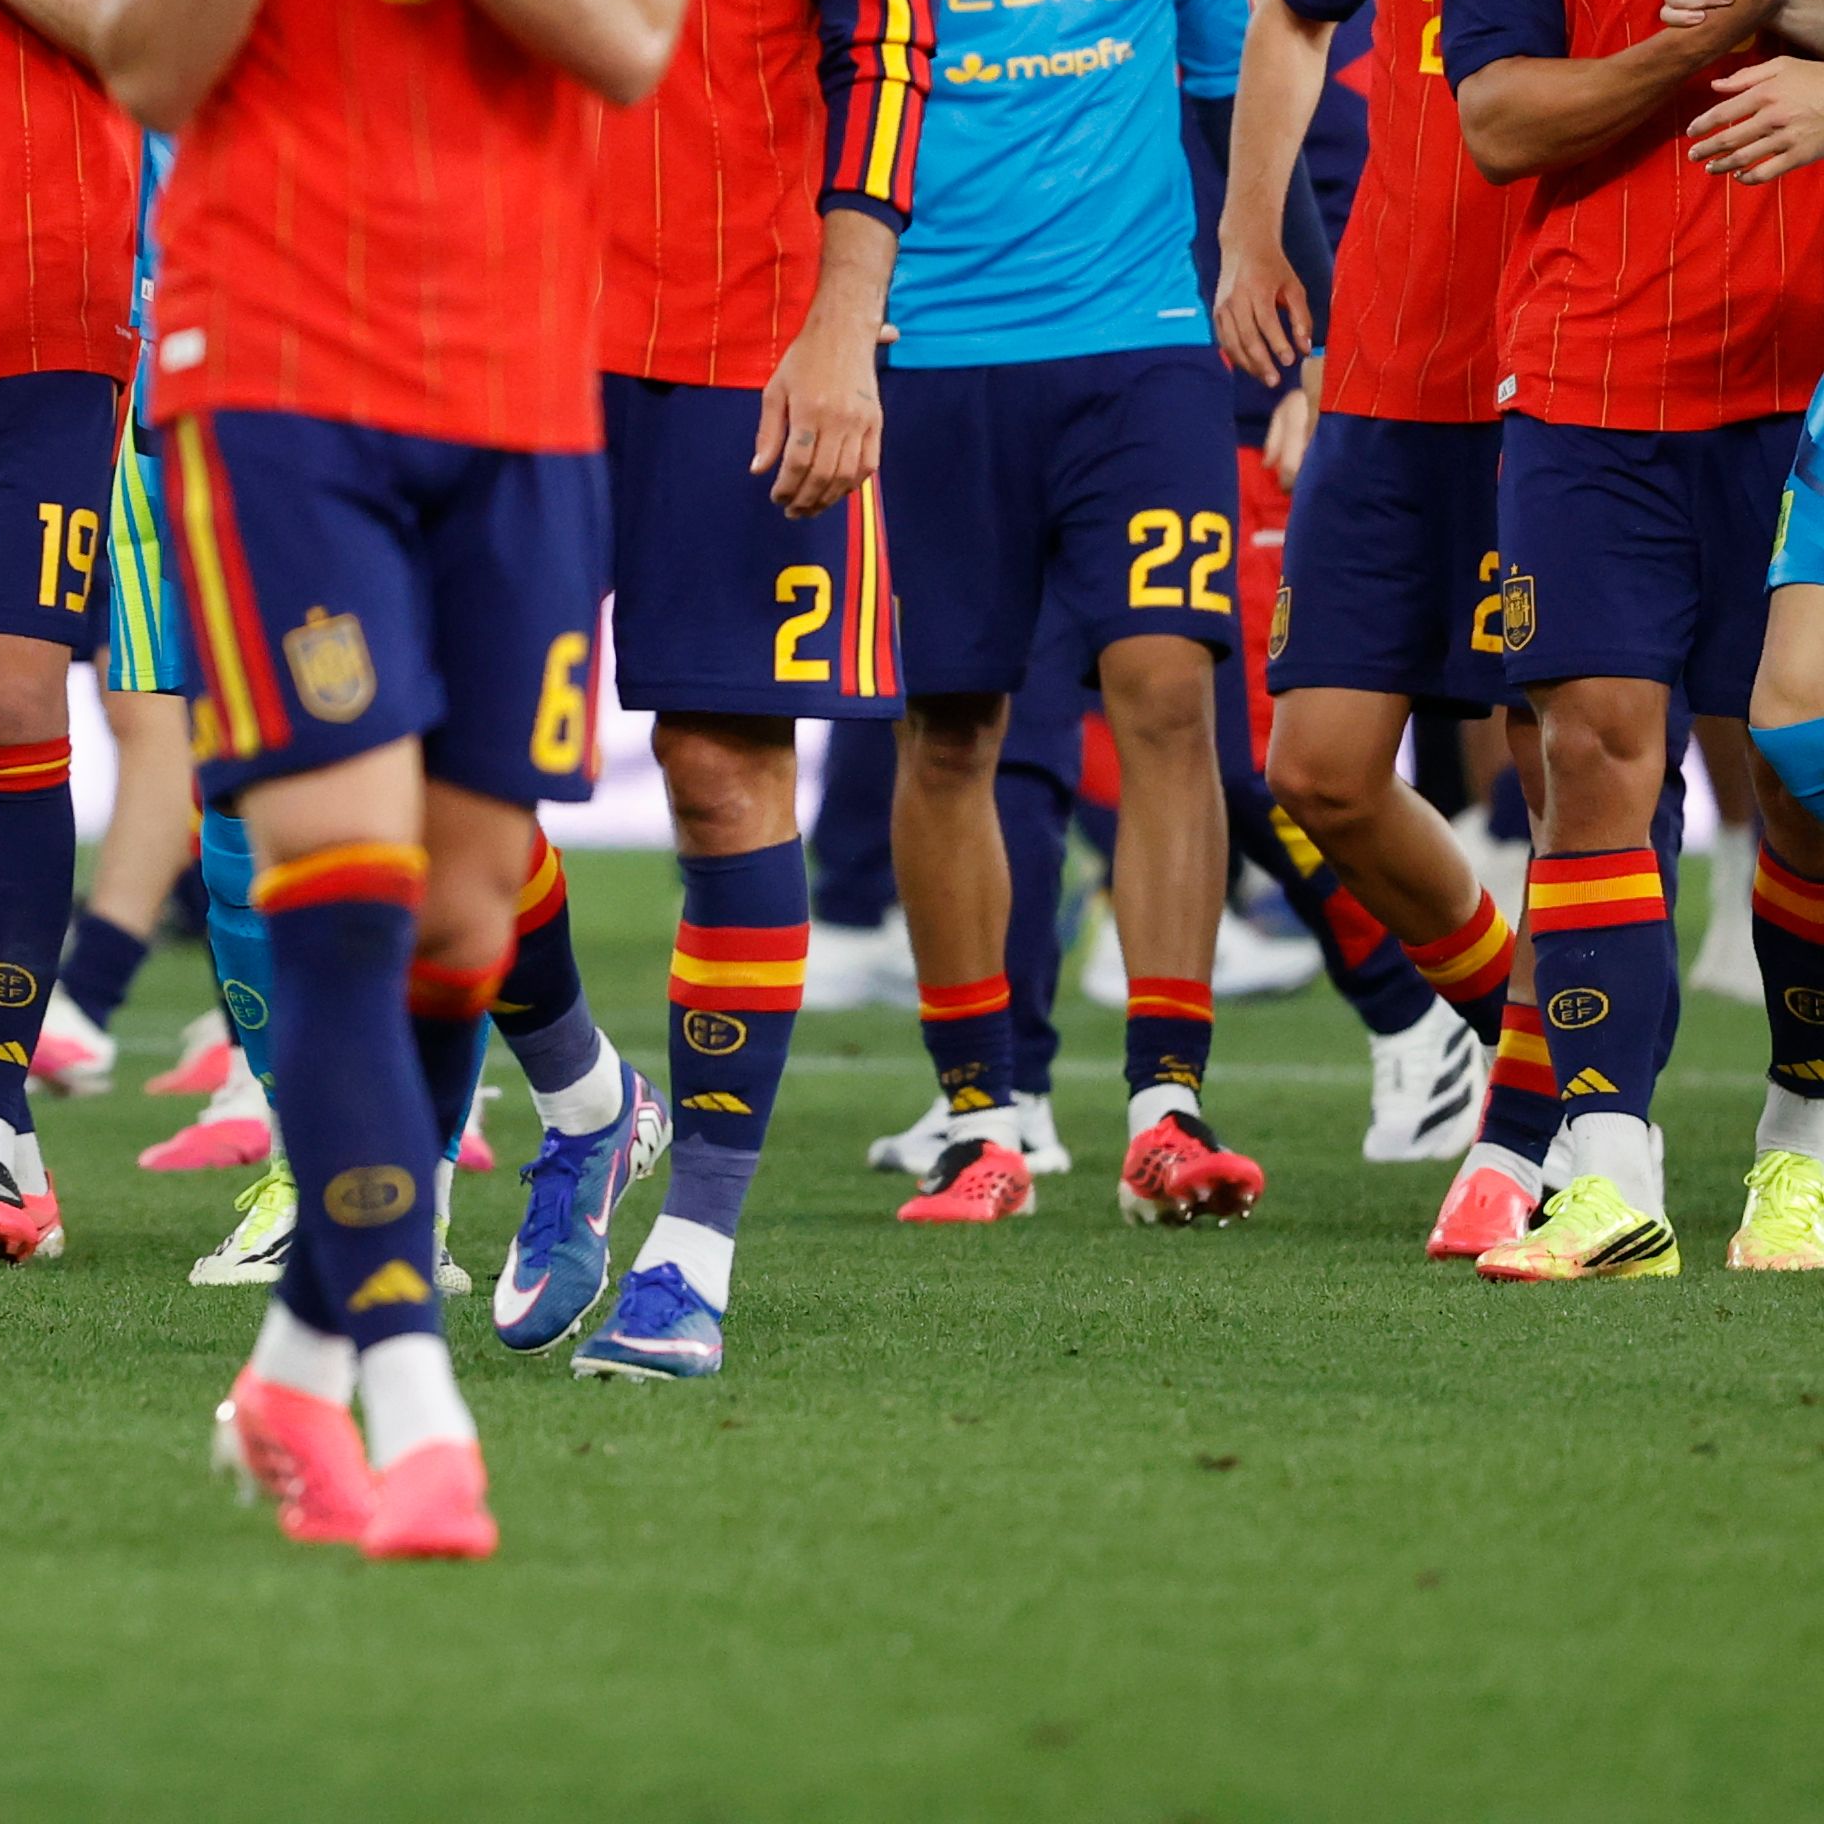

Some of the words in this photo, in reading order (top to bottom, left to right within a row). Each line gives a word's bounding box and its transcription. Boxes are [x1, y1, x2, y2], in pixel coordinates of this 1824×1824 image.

[39, 502, 100, 613] 19
[1128, 508, 1233, 615] 22
[774, 564, 833, 682] 2
[531, 630, 590, 775] 6
